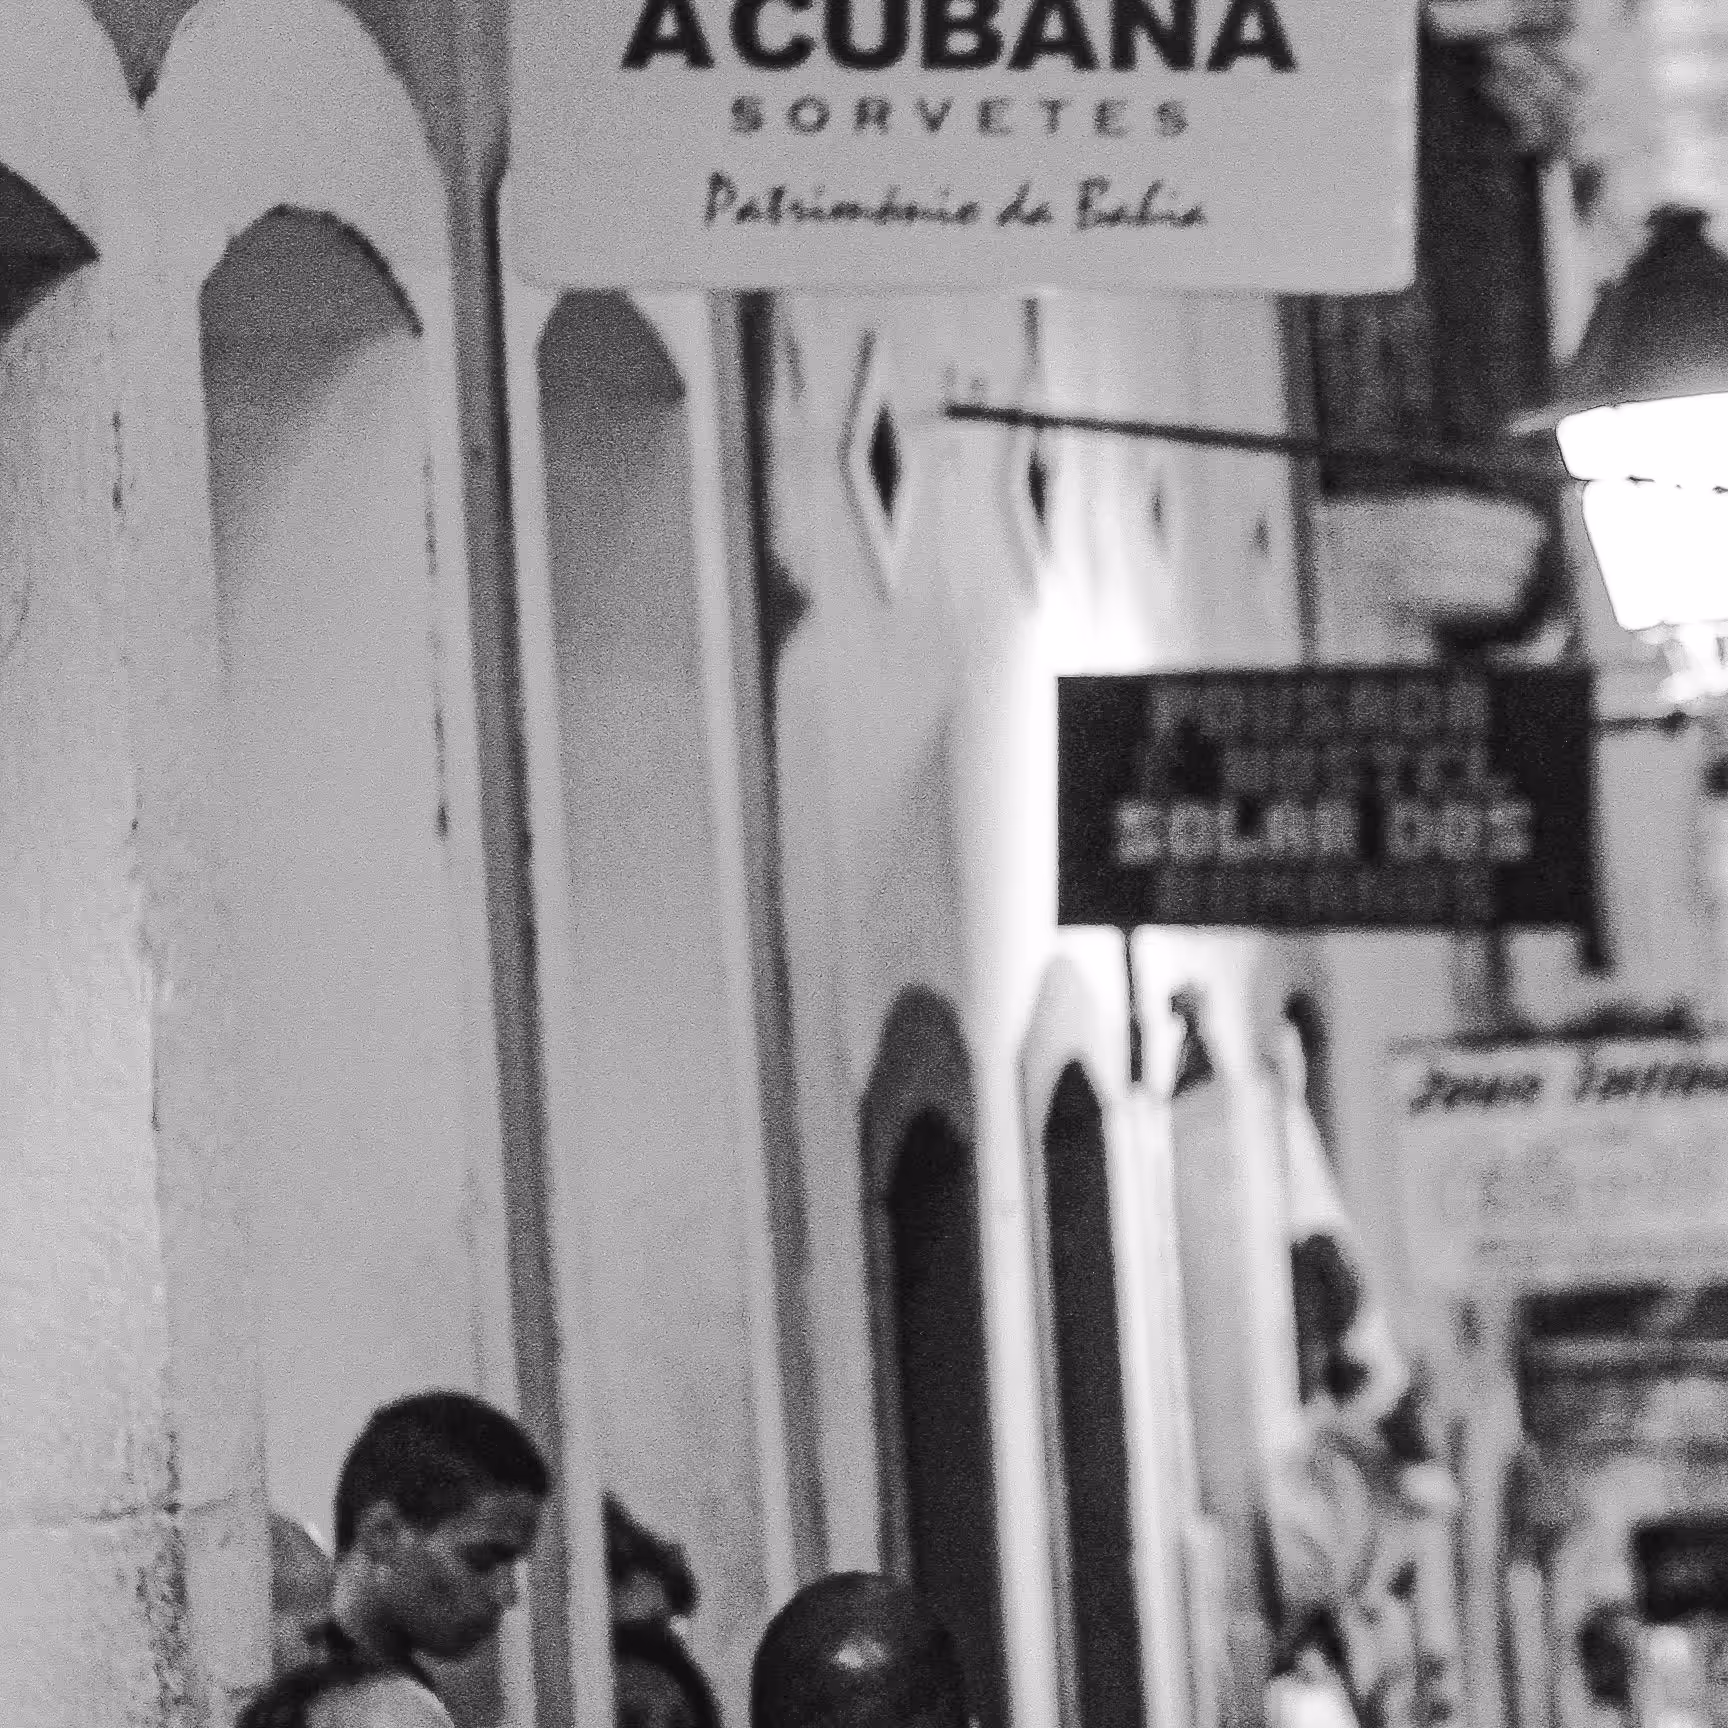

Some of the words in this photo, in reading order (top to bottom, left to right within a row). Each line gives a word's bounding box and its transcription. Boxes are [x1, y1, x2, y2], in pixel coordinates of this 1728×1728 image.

[731, 96, 1190, 137] SORVETES
[997, 177, 1052, 227] da
[1076, 175, 1206, 231] Bahia
[1116, 798, 1357, 863] SOLAR
[1387, 798, 1531, 862] DOS
